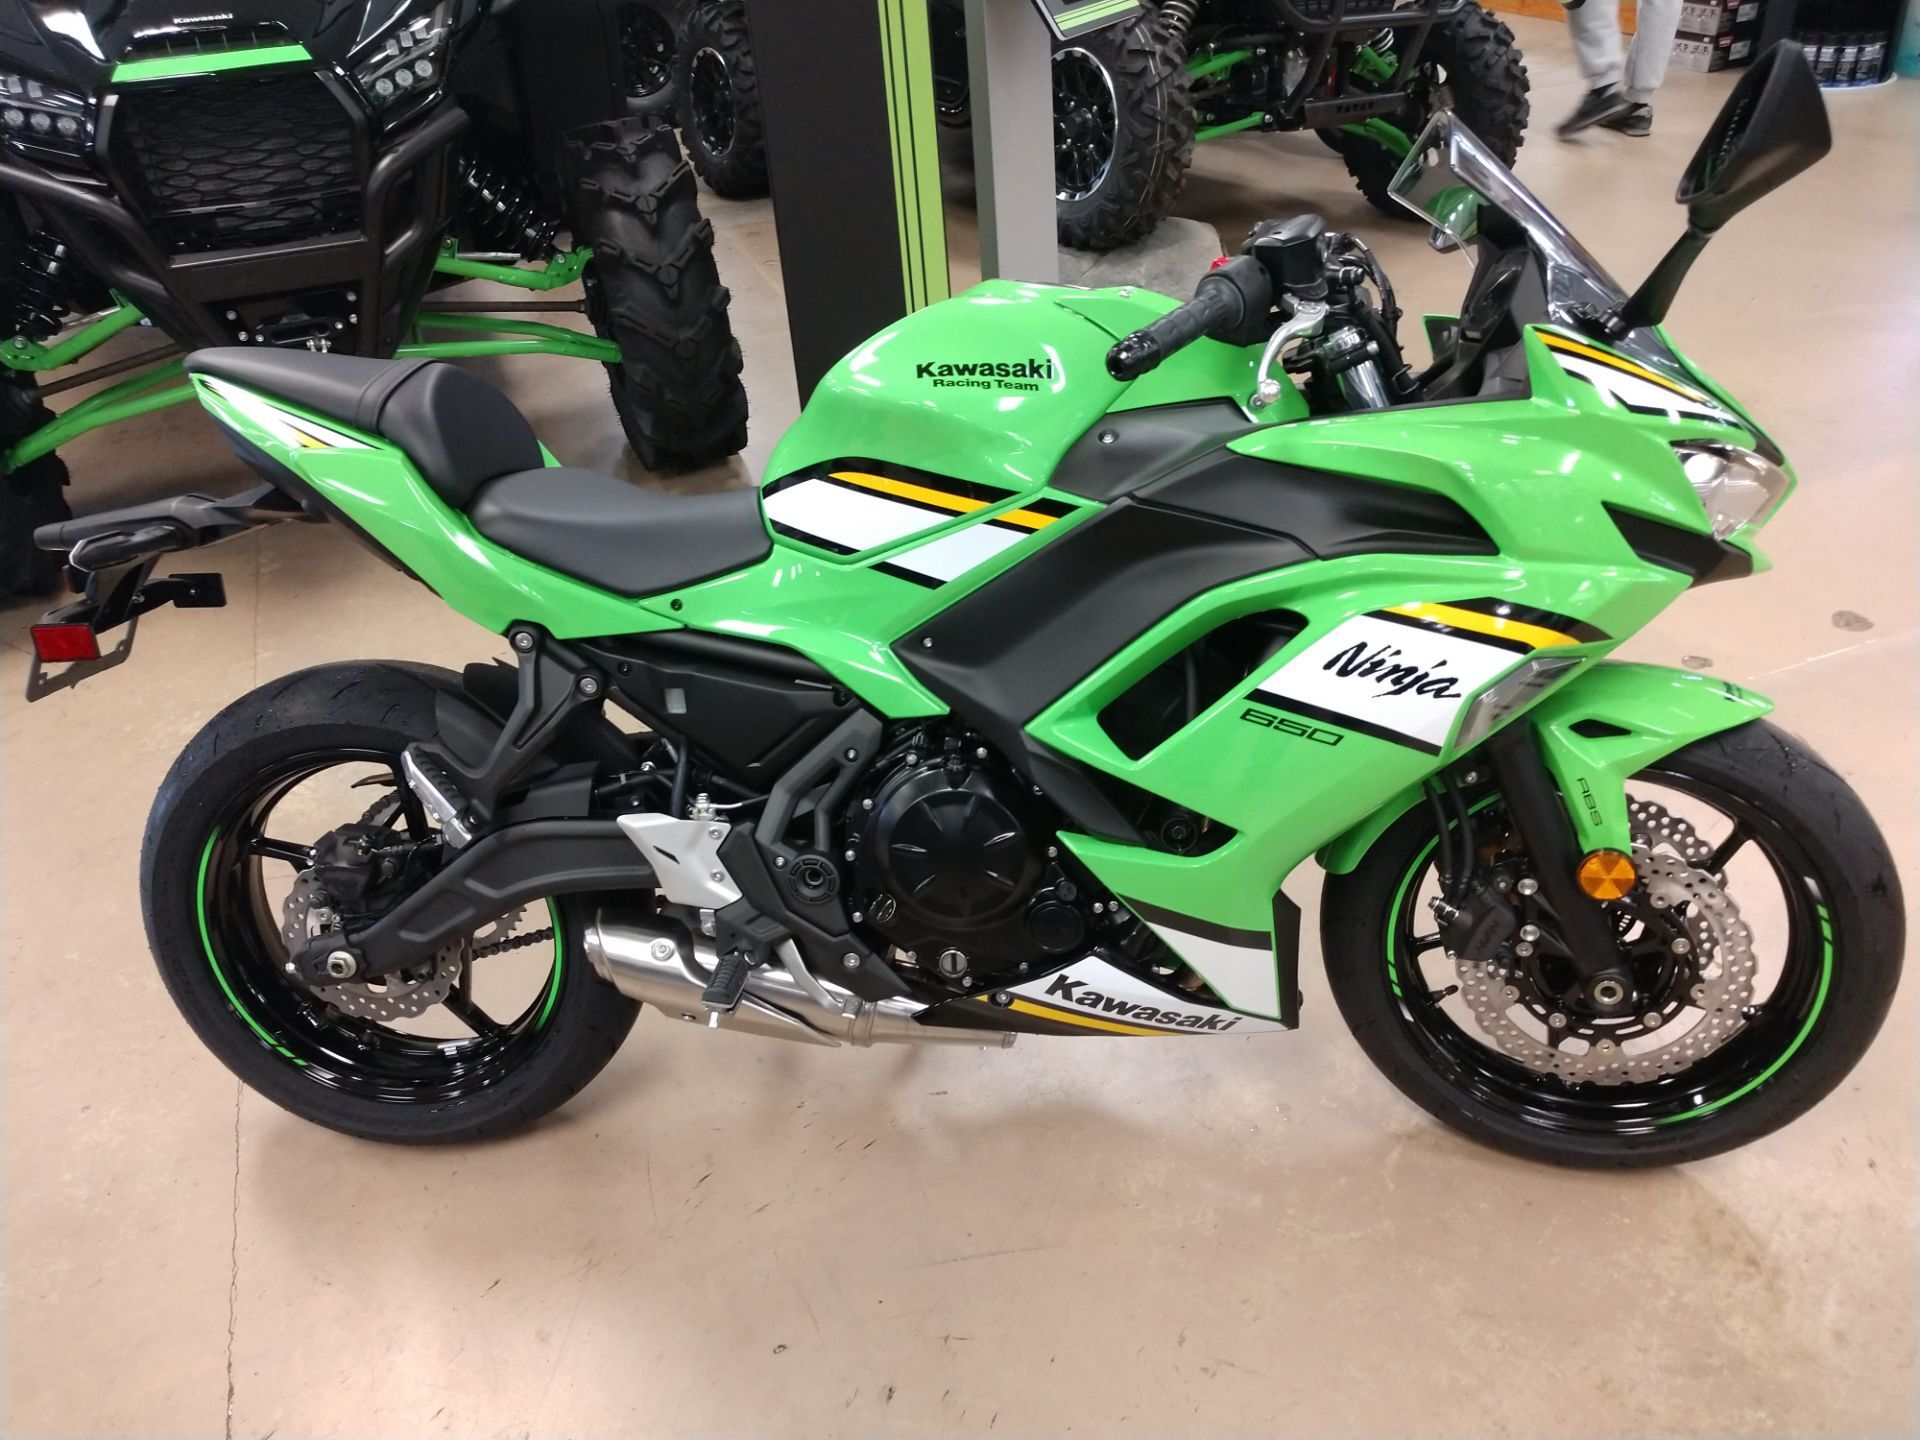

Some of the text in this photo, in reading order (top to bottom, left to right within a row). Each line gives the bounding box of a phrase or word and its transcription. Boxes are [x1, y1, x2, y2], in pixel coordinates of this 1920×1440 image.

[173, 13, 234, 24] Kawasaki
[916, 359, 1053, 379] Kawasaki
[932, 379, 1040, 391] Racing Team
[1322, 641, 1462, 698] Ninja
[1239, 708, 1345, 747] 650
[1576, 777, 1603, 826] ABS
[1044, 973, 1244, 1031] Kawasaki
